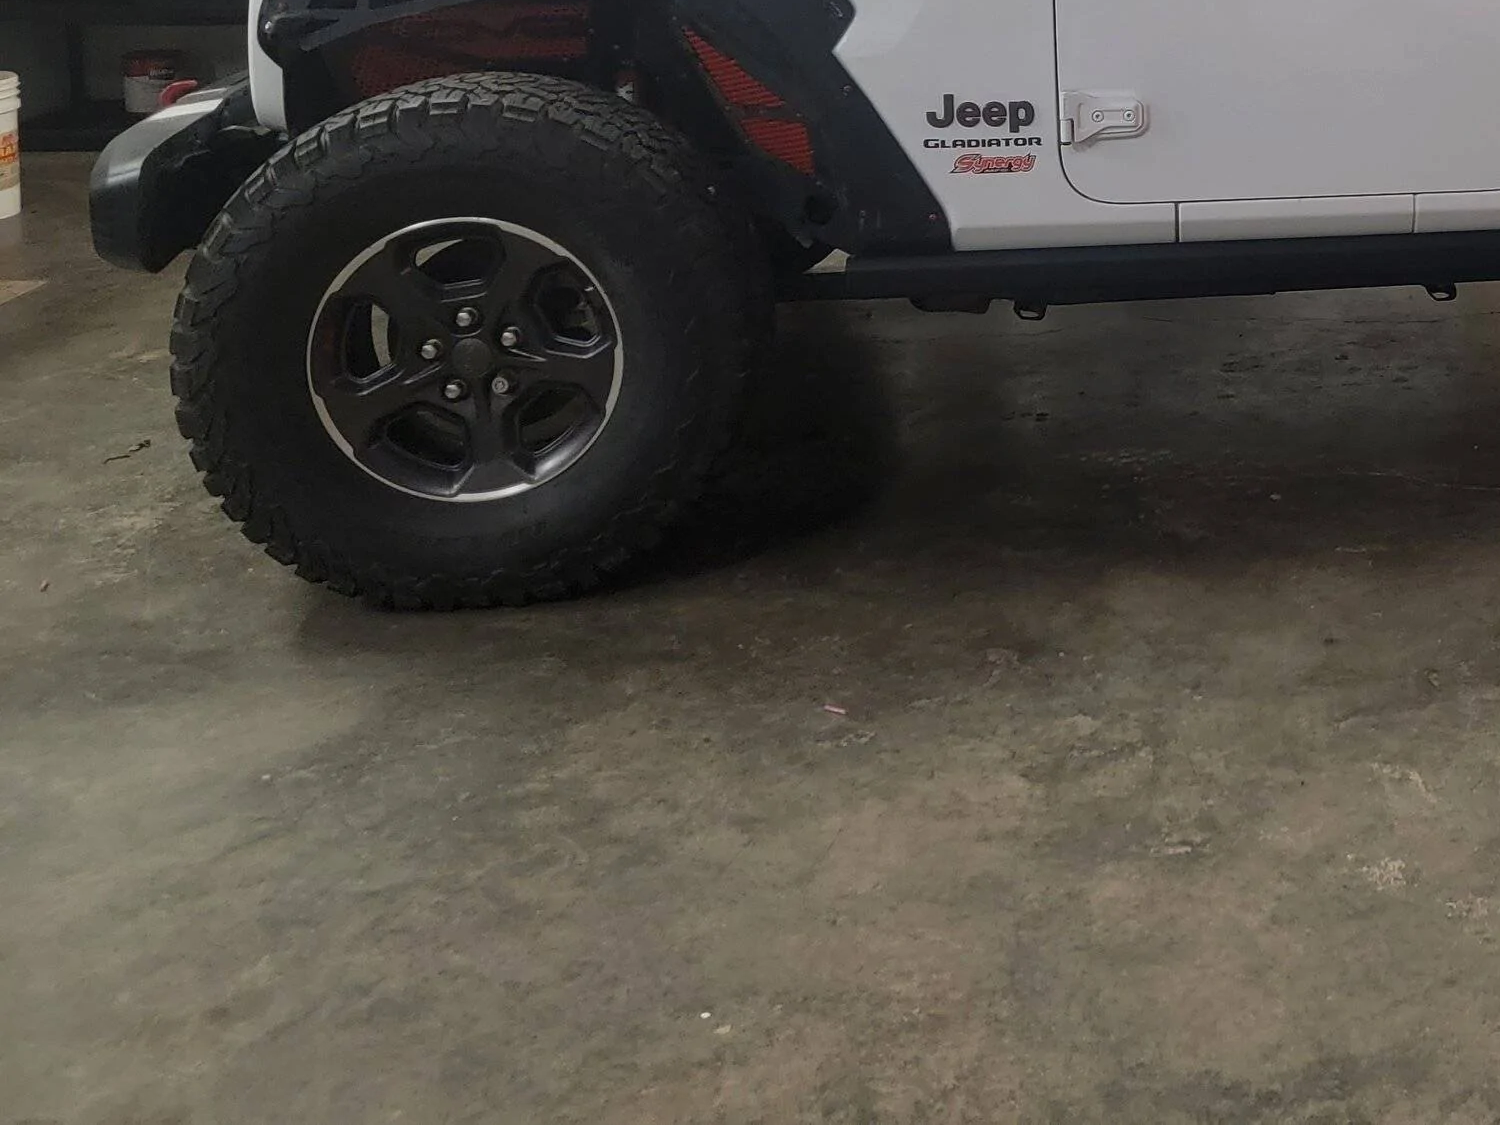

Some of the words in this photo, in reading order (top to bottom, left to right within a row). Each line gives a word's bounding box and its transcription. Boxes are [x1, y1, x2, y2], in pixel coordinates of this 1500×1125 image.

[925, 93, 1035, 133] Jeep
[923, 137, 1043, 148] GLADIATOR
[951, 153, 1037, 174] Synergy
